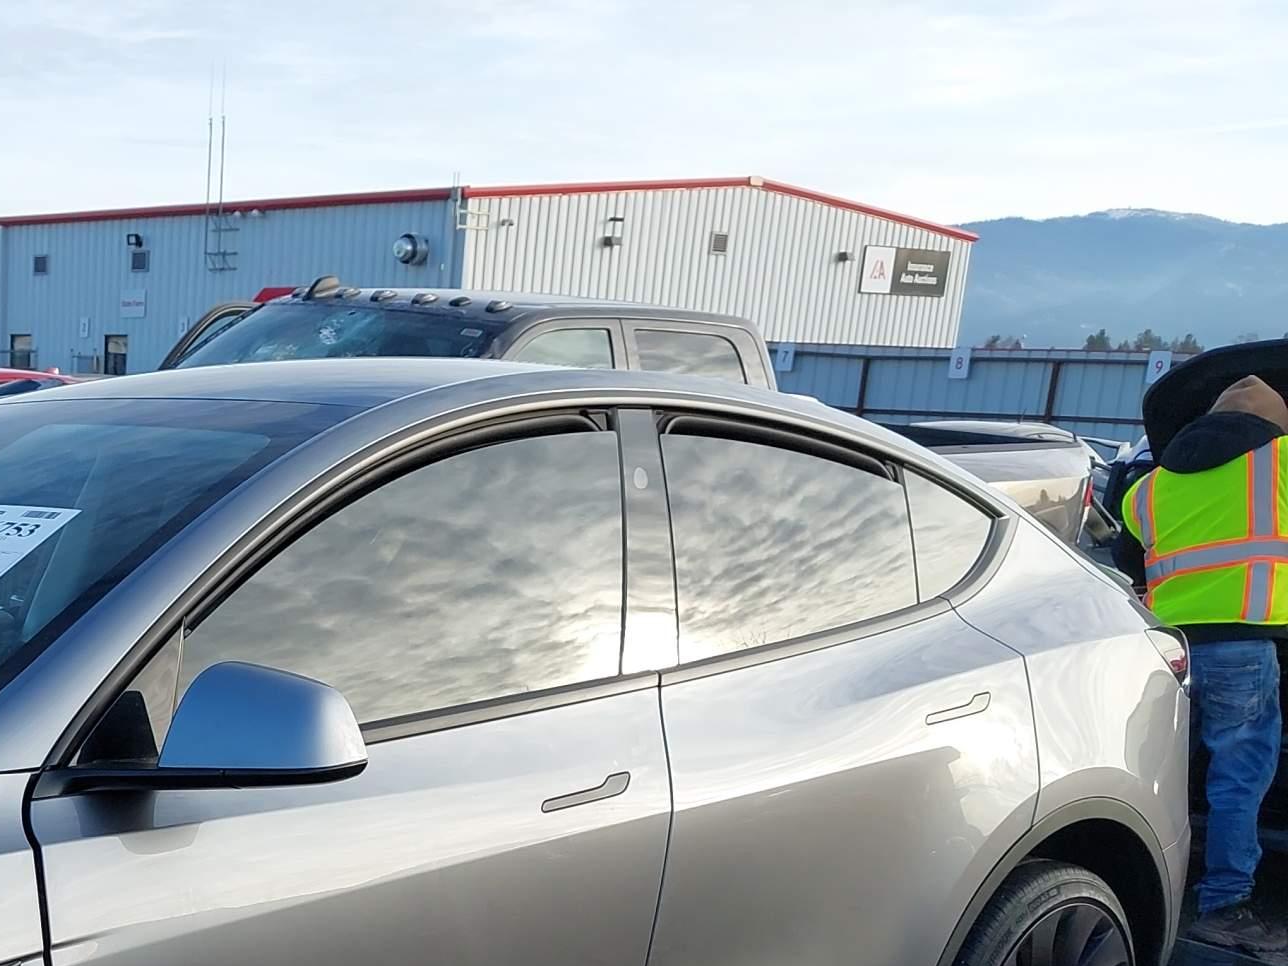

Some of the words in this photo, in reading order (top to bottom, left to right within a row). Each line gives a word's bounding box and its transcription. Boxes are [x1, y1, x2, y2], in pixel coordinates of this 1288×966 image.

[781, 350, 789, 363] 7
[955, 356, 964, 370] 8
[1155, 360, 1164, 374] 9
